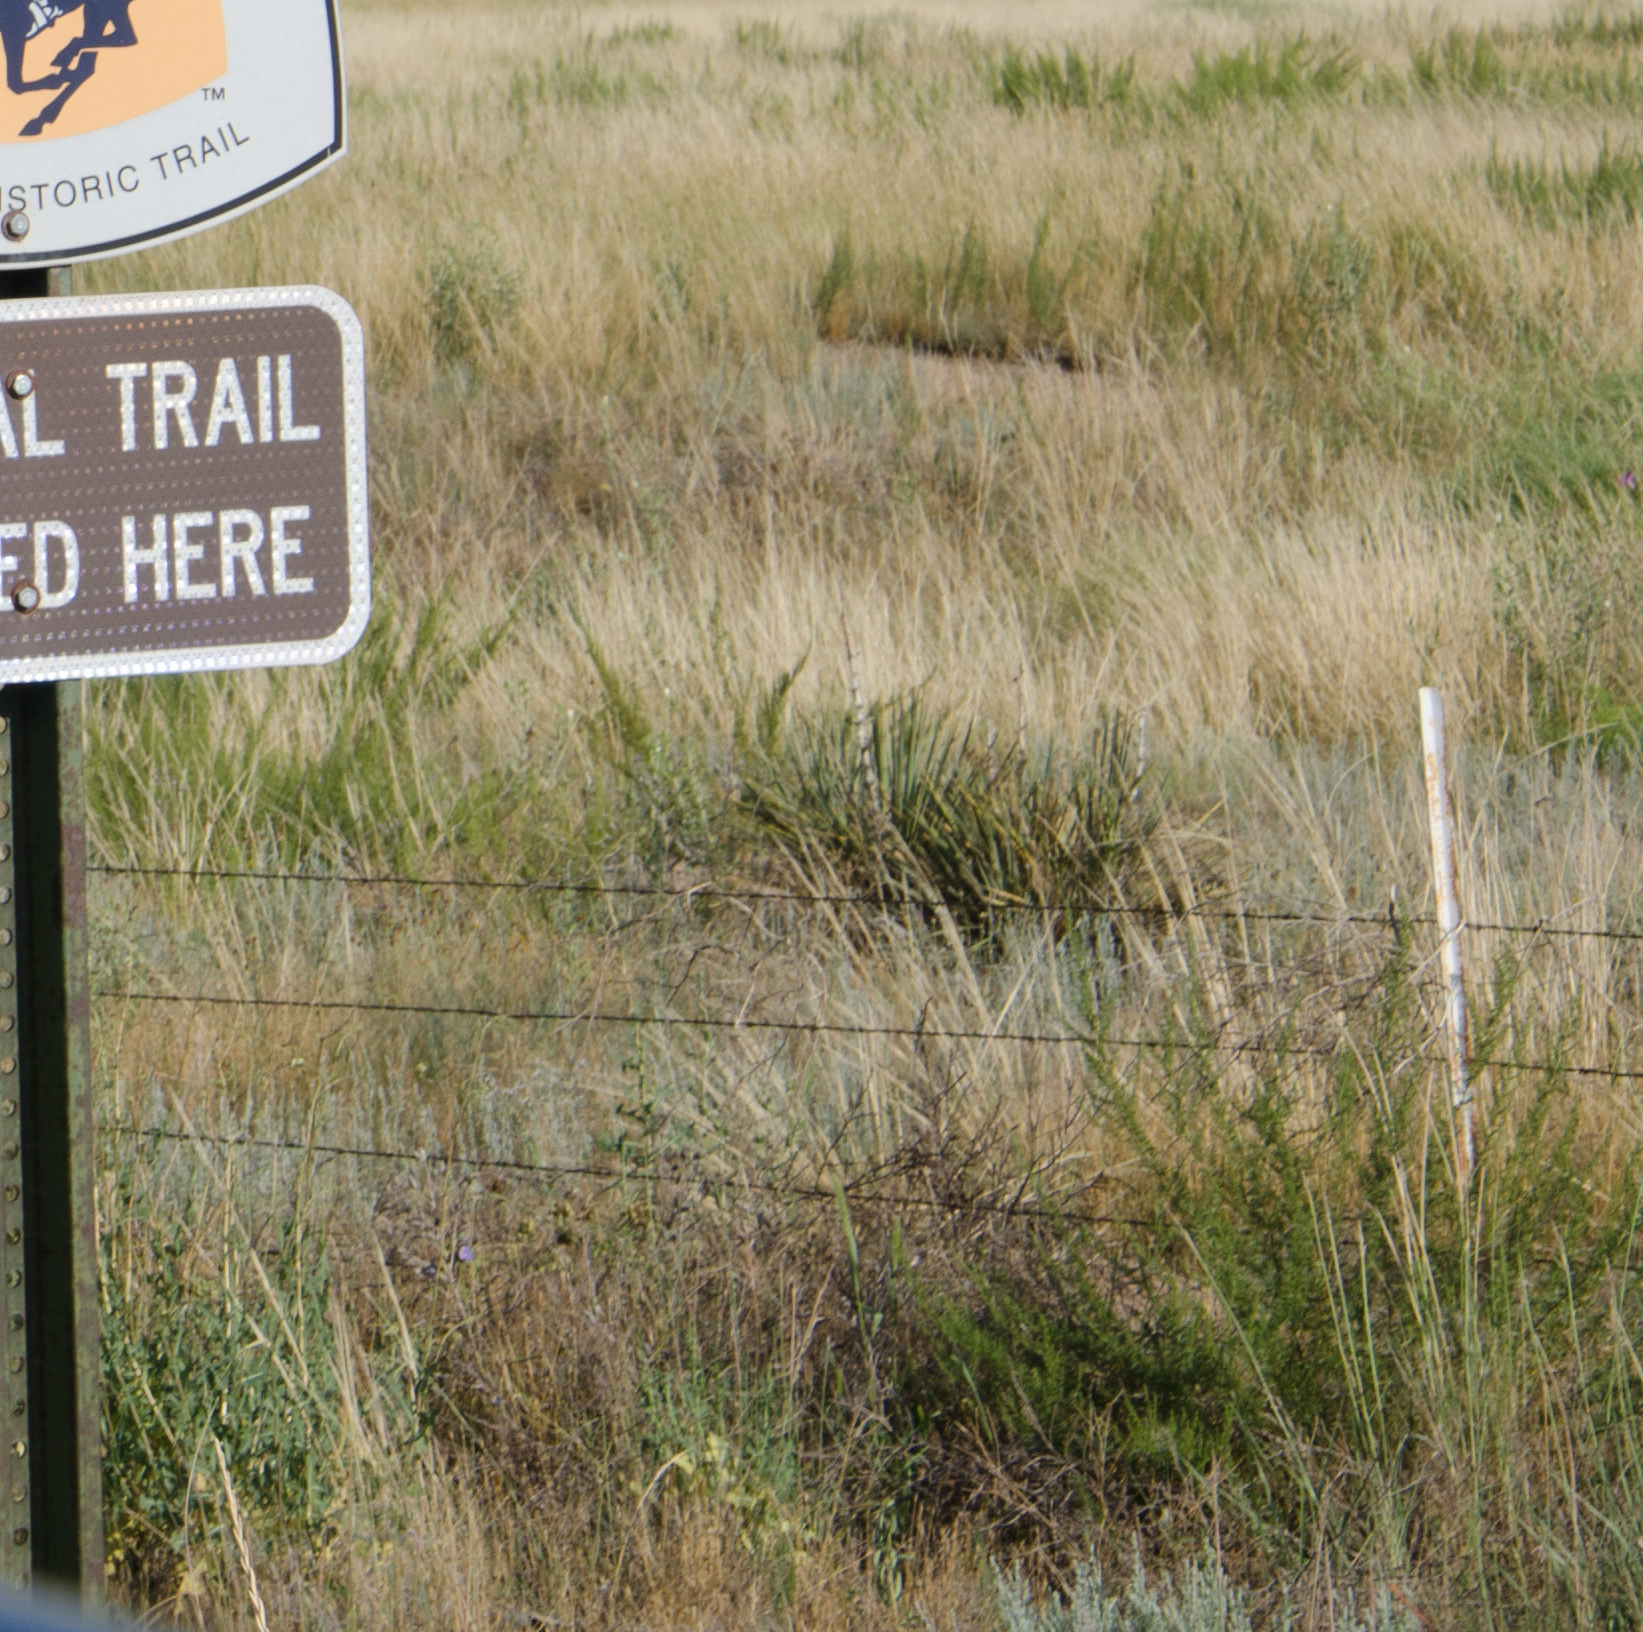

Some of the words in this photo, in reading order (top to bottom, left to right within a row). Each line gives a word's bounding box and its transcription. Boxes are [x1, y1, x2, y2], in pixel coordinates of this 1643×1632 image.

[150, 121, 250, 181] TRAIL
[106, 354, 321, 451] TRAIL
[121, 505, 315, 603] HERE
